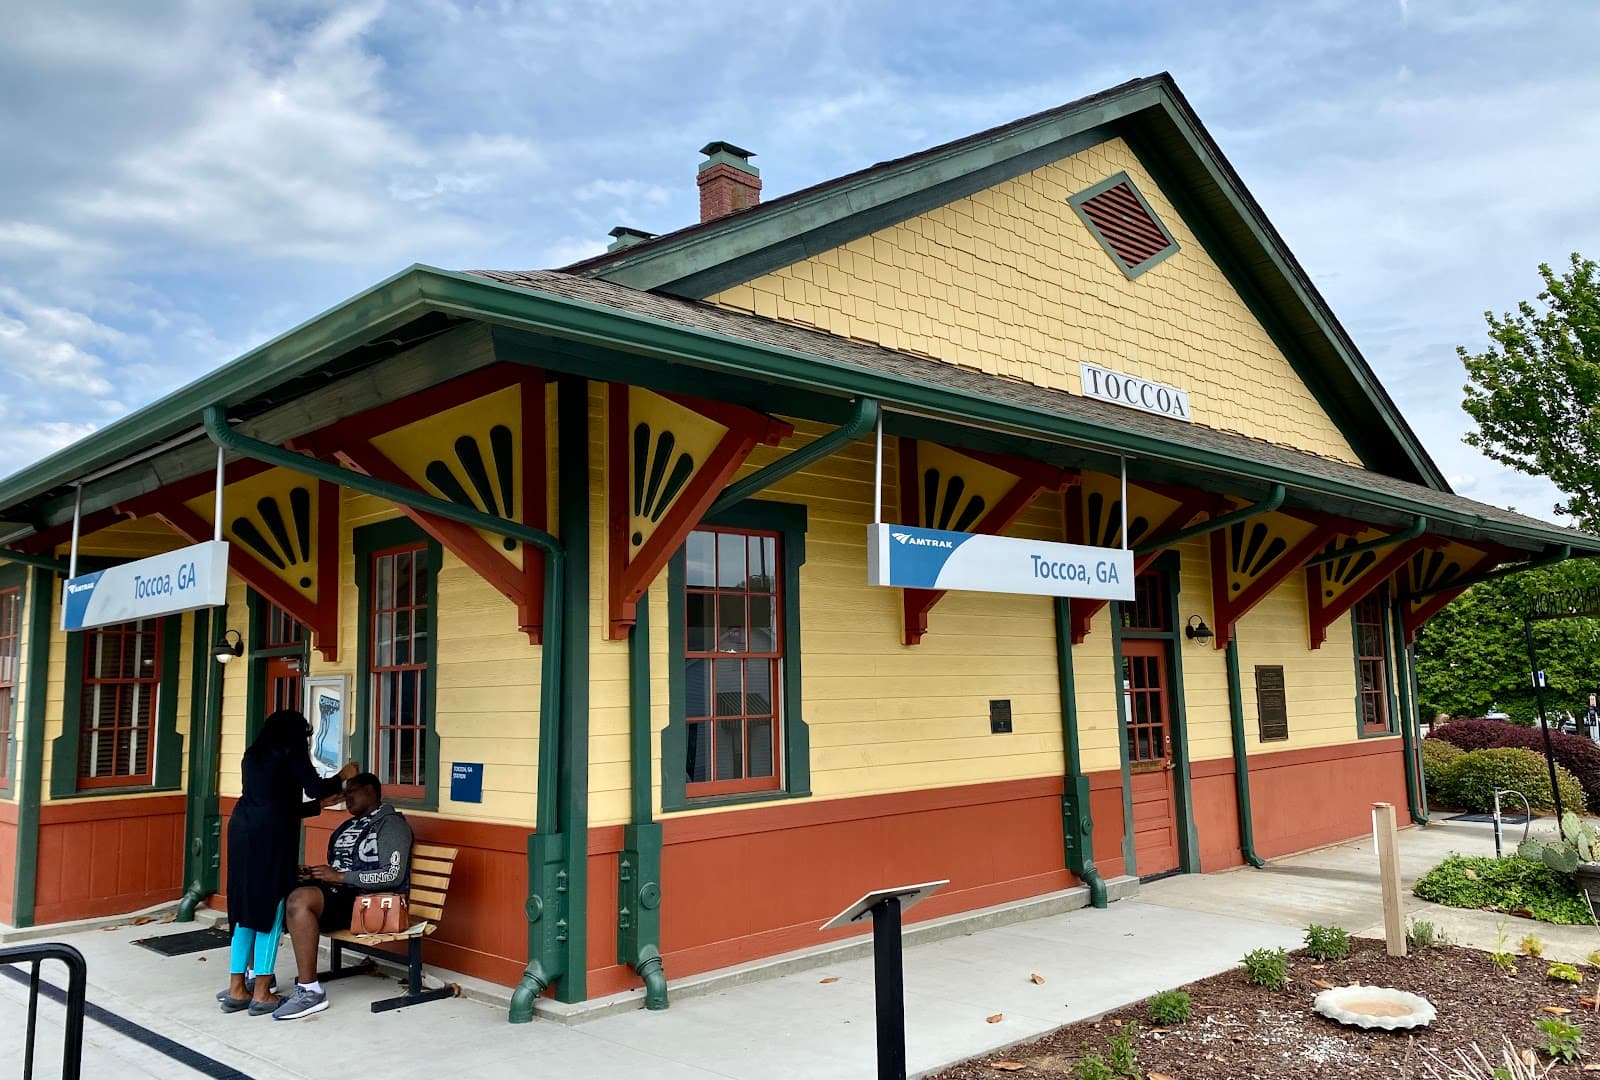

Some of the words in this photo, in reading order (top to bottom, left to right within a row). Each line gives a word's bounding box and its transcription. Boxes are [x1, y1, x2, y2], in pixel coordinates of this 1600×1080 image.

[1087, 368, 1185, 416] TOCCOA
[909, 537, 953, 549] AMTRAK
[134, 574, 174, 600] Toccoa,
[177, 562, 196, 590] GA
[1030, 554, 1091, 585] Toccoa,
[1096, 561, 1120, 584] GA
